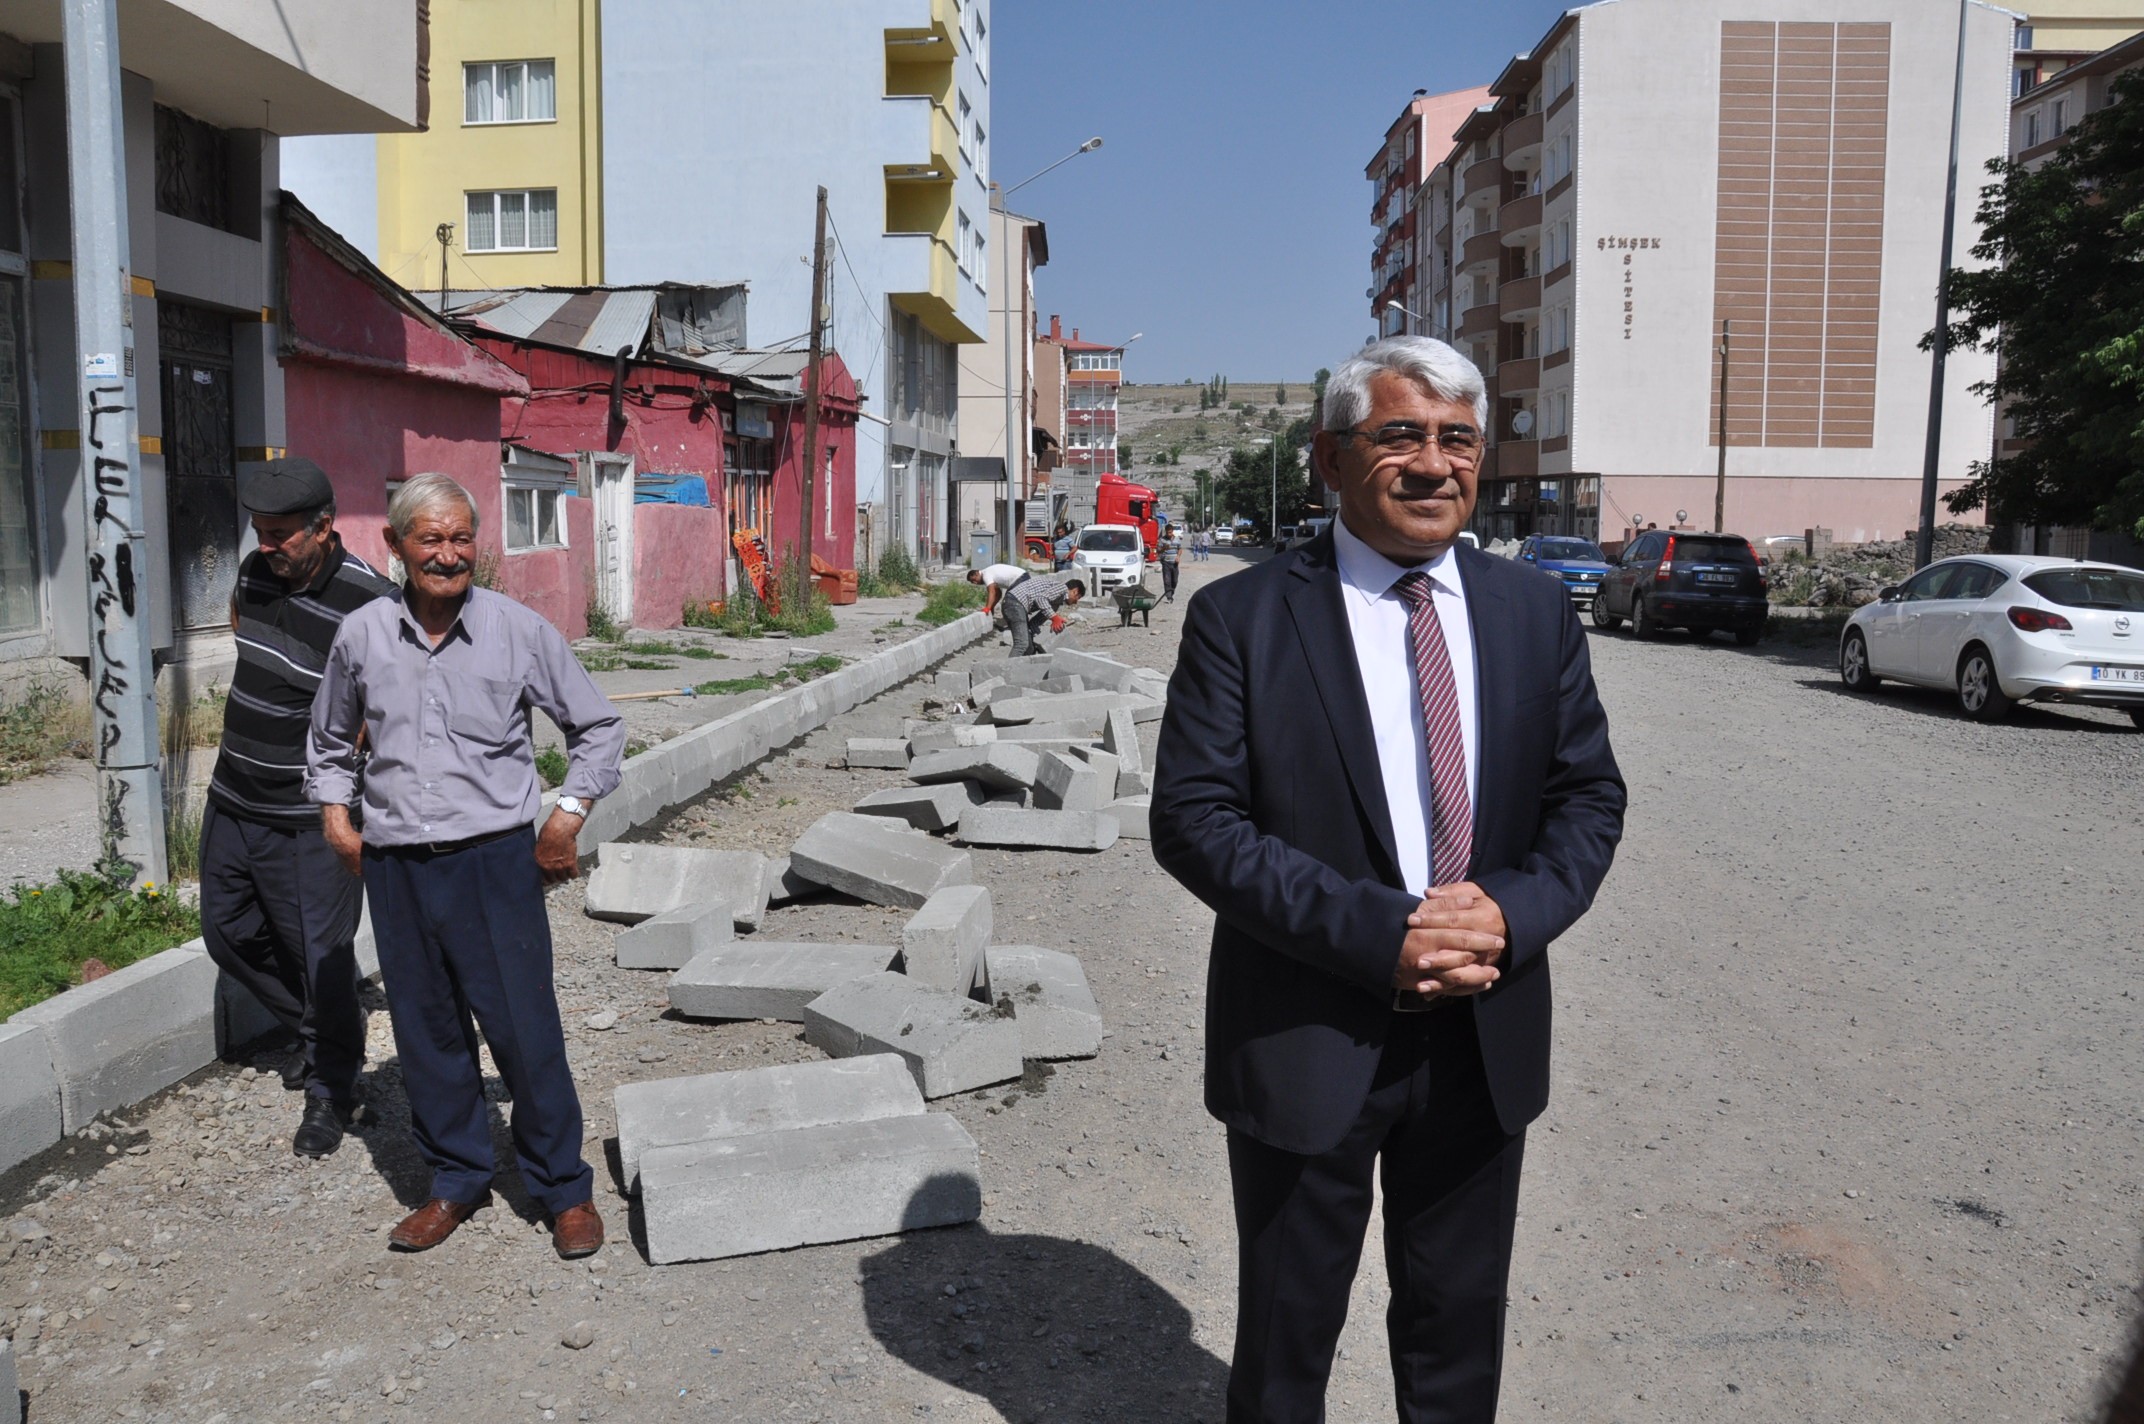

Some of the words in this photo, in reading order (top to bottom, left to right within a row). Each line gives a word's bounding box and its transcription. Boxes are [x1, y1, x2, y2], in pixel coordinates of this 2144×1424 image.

[1597, 235, 1661, 251] ŞİMŞEK
[2097, 669, 2108, 678] 10
[2115, 670, 2126, 679] YK
